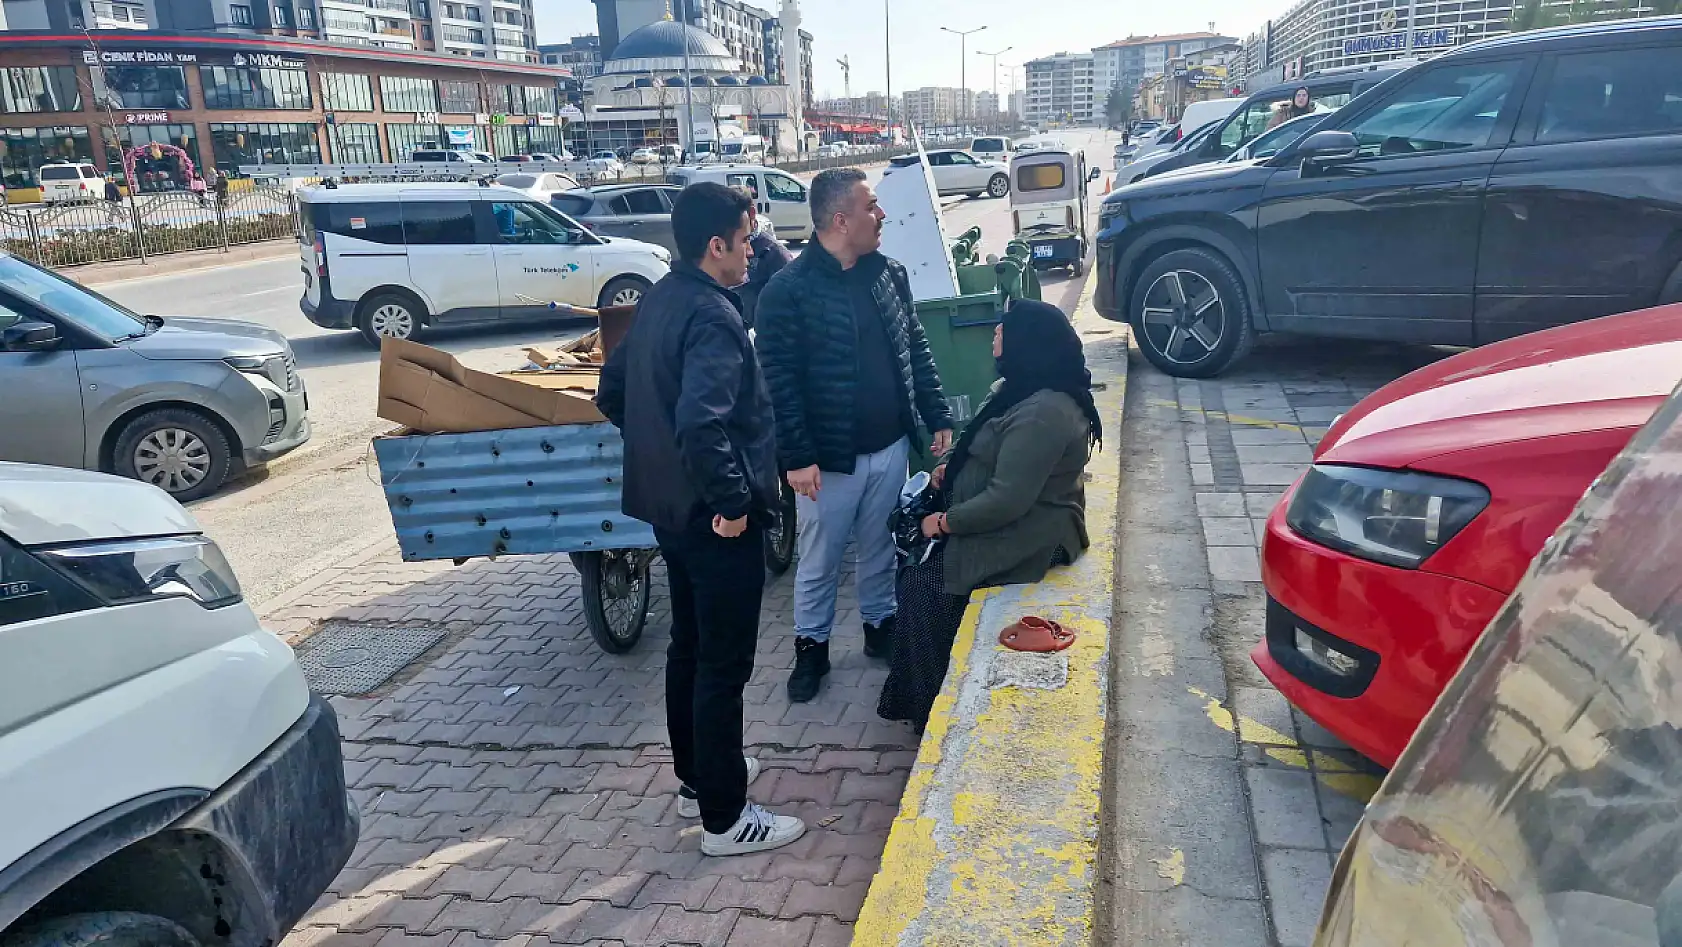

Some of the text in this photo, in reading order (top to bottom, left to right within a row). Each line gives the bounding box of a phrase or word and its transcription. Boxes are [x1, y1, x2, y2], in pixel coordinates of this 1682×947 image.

[101, 51, 136, 62] CENK
[137, 50, 173, 62] FİDAN
[248, 53, 283, 67] MKM
[3, 583, 29, 596] 160
